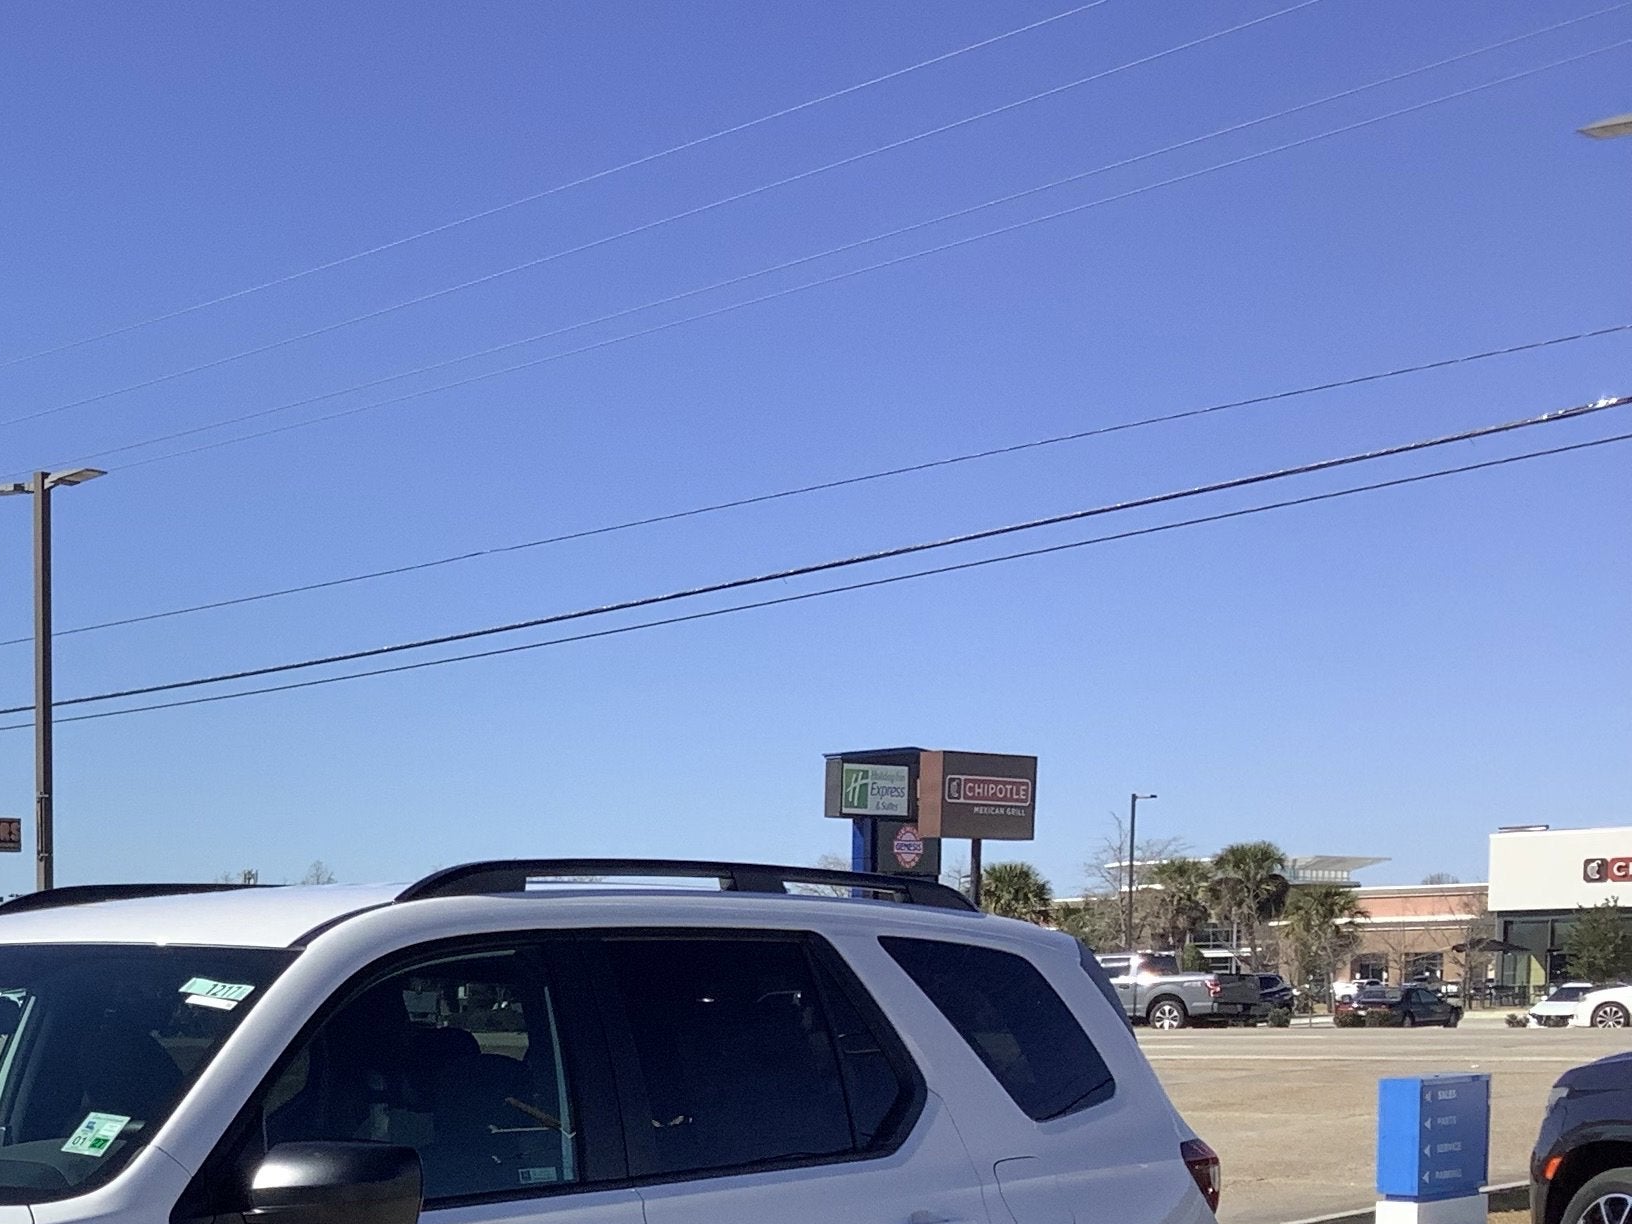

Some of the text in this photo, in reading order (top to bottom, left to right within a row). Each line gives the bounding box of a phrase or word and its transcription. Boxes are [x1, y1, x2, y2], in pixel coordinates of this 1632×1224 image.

[870, 781, 906, 800] Express
[965, 783, 1028, 799] CHIPOTLE
[973, 806, 1026, 817] MEXICAN GRILL
[206, 983, 243, 998] 1217
[71, 1135, 87, 1146] 01
